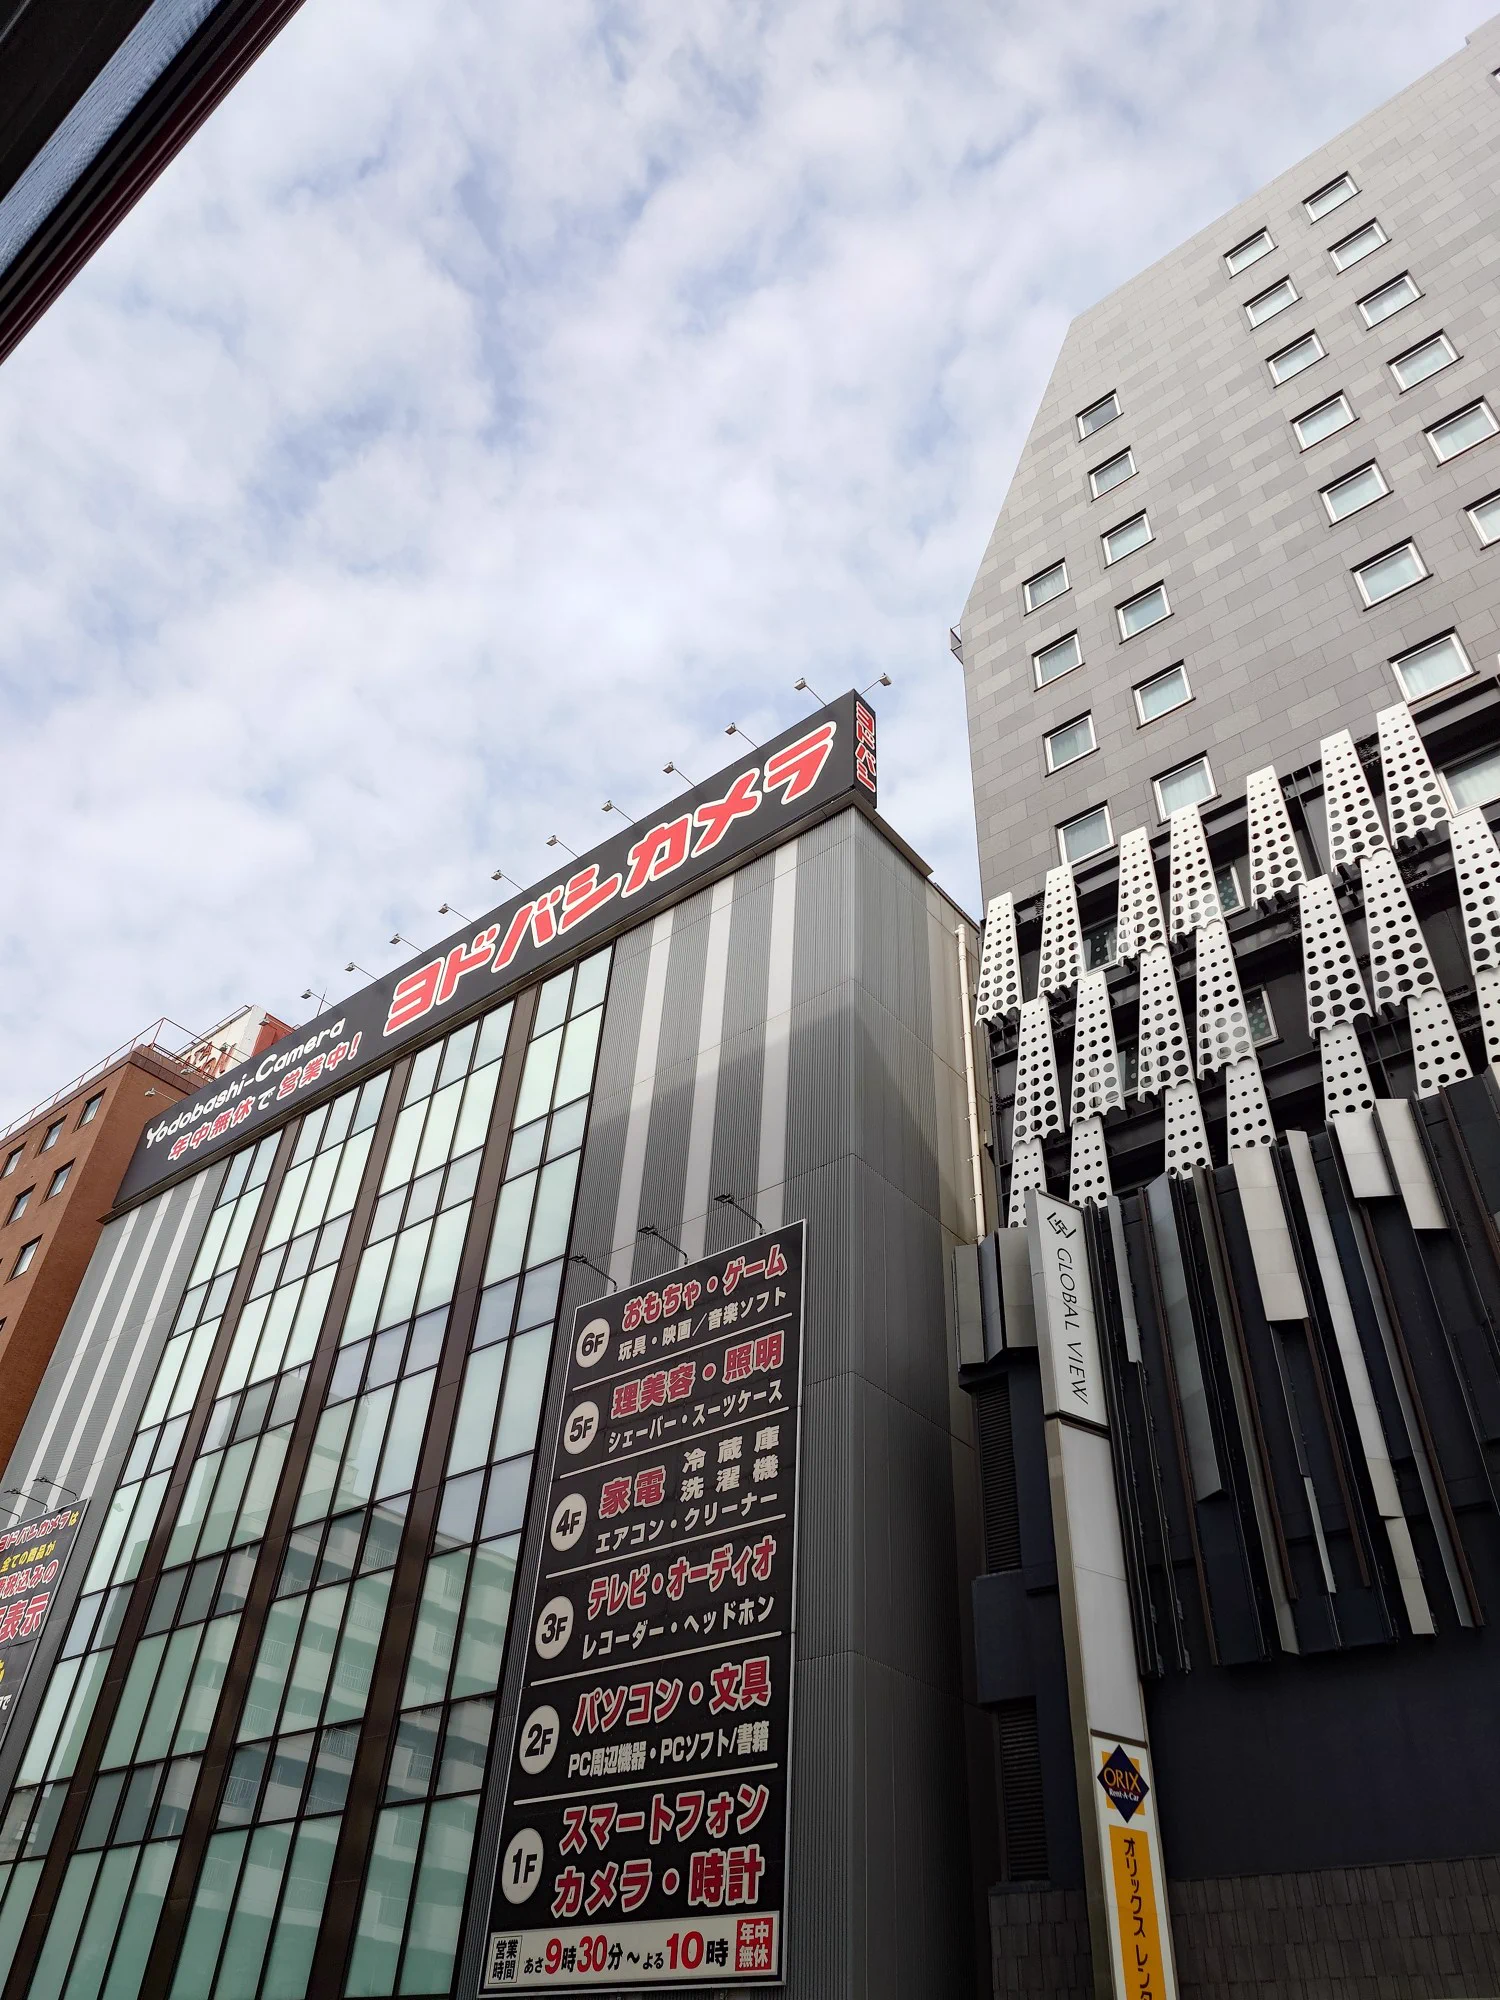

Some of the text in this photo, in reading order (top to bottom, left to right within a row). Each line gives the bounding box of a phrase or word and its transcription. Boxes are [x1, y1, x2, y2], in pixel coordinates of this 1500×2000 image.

[382, 721, 838, 1037] ヨドバシカメラ
[146, 1018, 346, 1149] Yodobashi-Camera
[621, 1243, 788, 1332] おもちゃ・ゲーム
[581, 1332, 606, 1357] 6F
[1057, 1247, 1089, 1405] GLOBAL VIEW
[611, 1330, 785, 1420] 理美容・照明
[569, 1416, 594, 1443] 5F
[608, 1379, 783, 1454] シェーバー・スーツケース
[680, 1454, 779, 1503] 洗濯機
[682, 1425, 781, 1474] 冷蔵庫
[555, 1509, 582, 1537] 4F
[595, 1492, 778, 1554] エアコン・クリーナー
[599, 1465, 667, 1520] 家電
[587, 1535, 777, 1621] テレビ・オーディオ
[541, 1613, 569, 1644] 3F
[582, 1596, 775, 1660] レコーダー・ヘッドホン
[571, 1656, 772, 1737] パソコン・文具
[524, 1724, 554, 1758] 2F
[1103, 1767, 1142, 1793] ORIX
[1108, 1788, 1140, 1802] Rent-A-Car
[558, 1783, 770, 1856] スマートフォン
[512, 1848, 538, 1885] 1F
[551, 1844, 765, 1918] カメラ・時計
